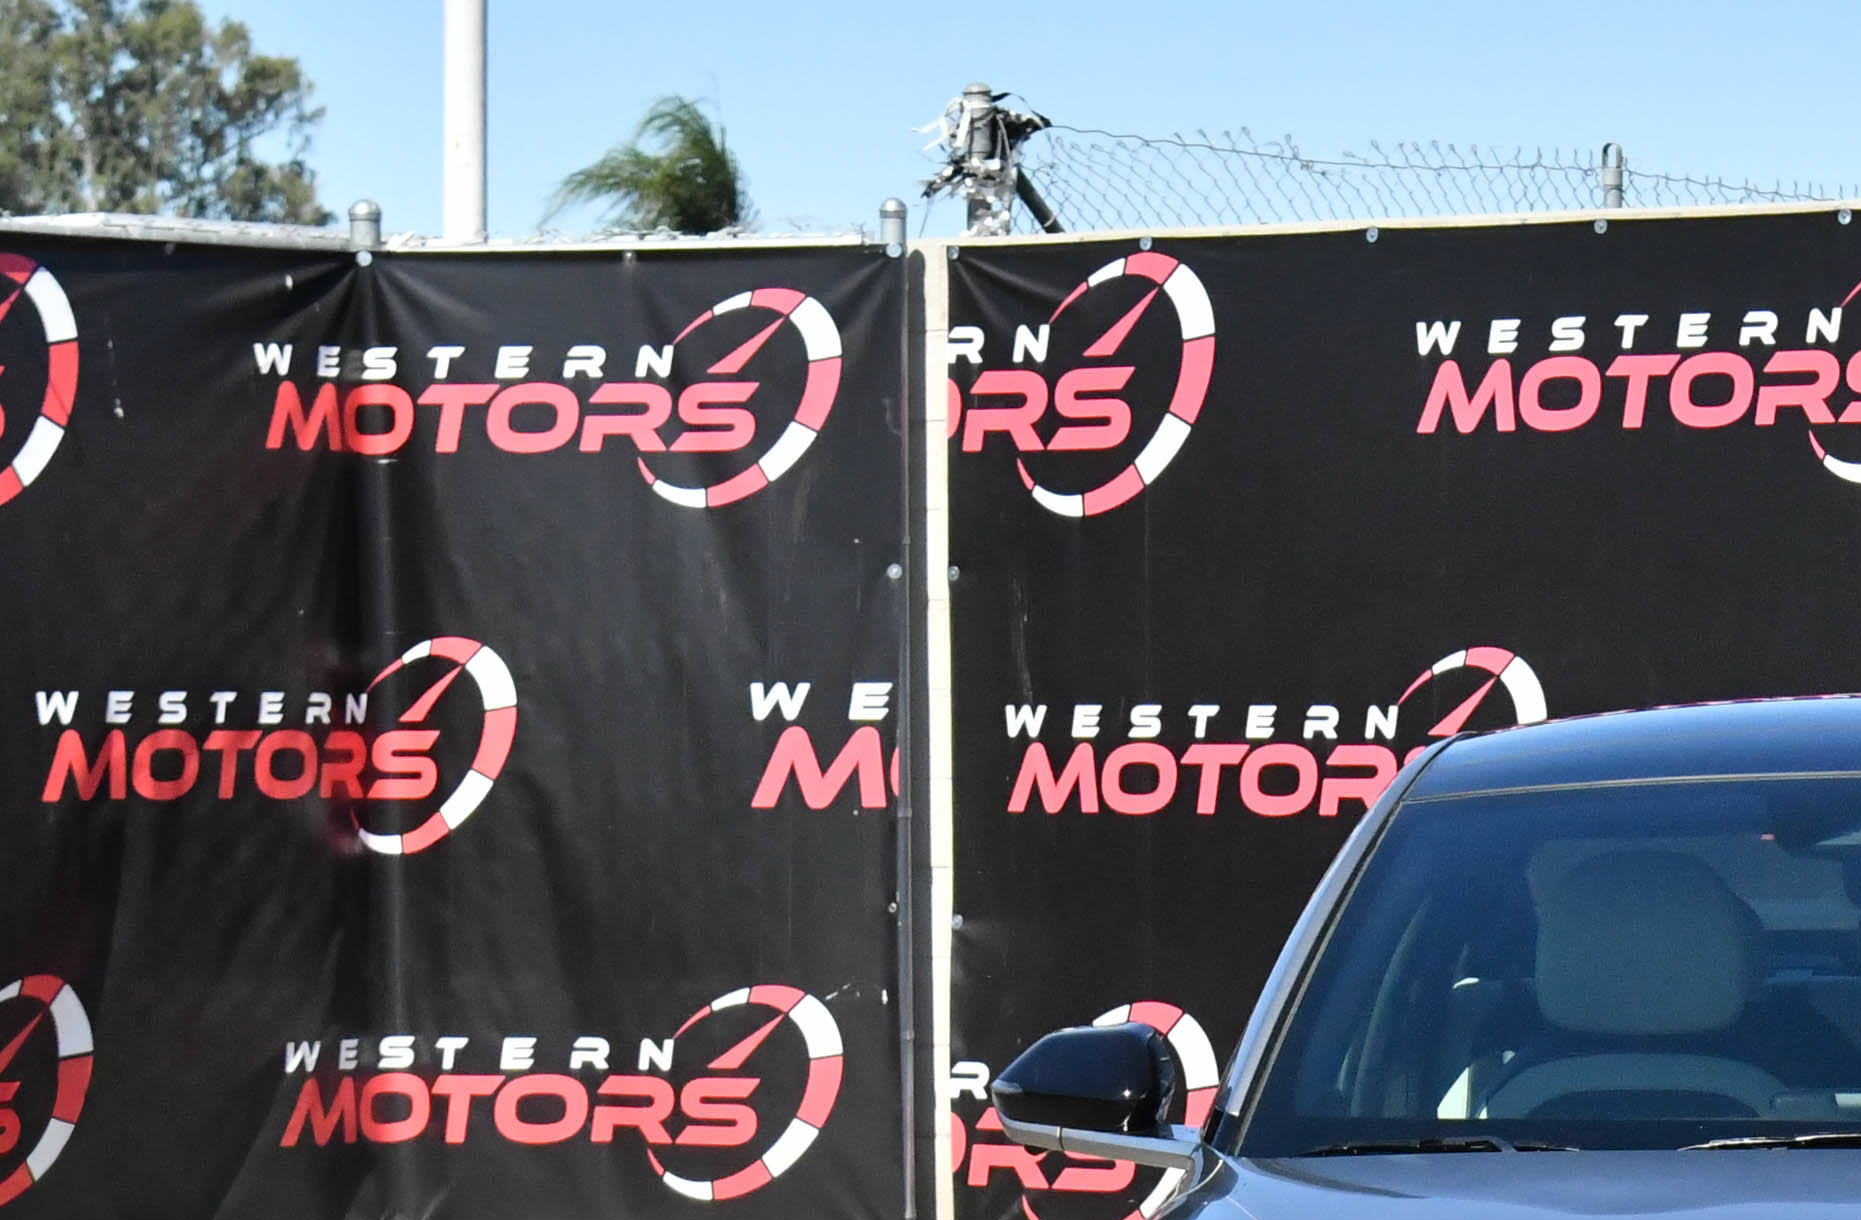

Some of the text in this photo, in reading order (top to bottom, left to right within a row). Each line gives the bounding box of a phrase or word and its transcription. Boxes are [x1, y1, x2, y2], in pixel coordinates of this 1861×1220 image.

[254, 343, 675, 379] WESTERN
[1416, 307, 1843, 355] WESTERN
[266, 381, 761, 455] MOTORS
[36, 691, 368, 725] WESTERN
[1005, 704, 1399, 739] WESTERN
[41, 729, 441, 802] MOTORS
[751, 726, 900, 809] M
[1008, 741, 1428, 816] MOTOR
[286, 1036, 675, 1072] WESTERN
[280, 1074, 760, 1147] MOTORS
